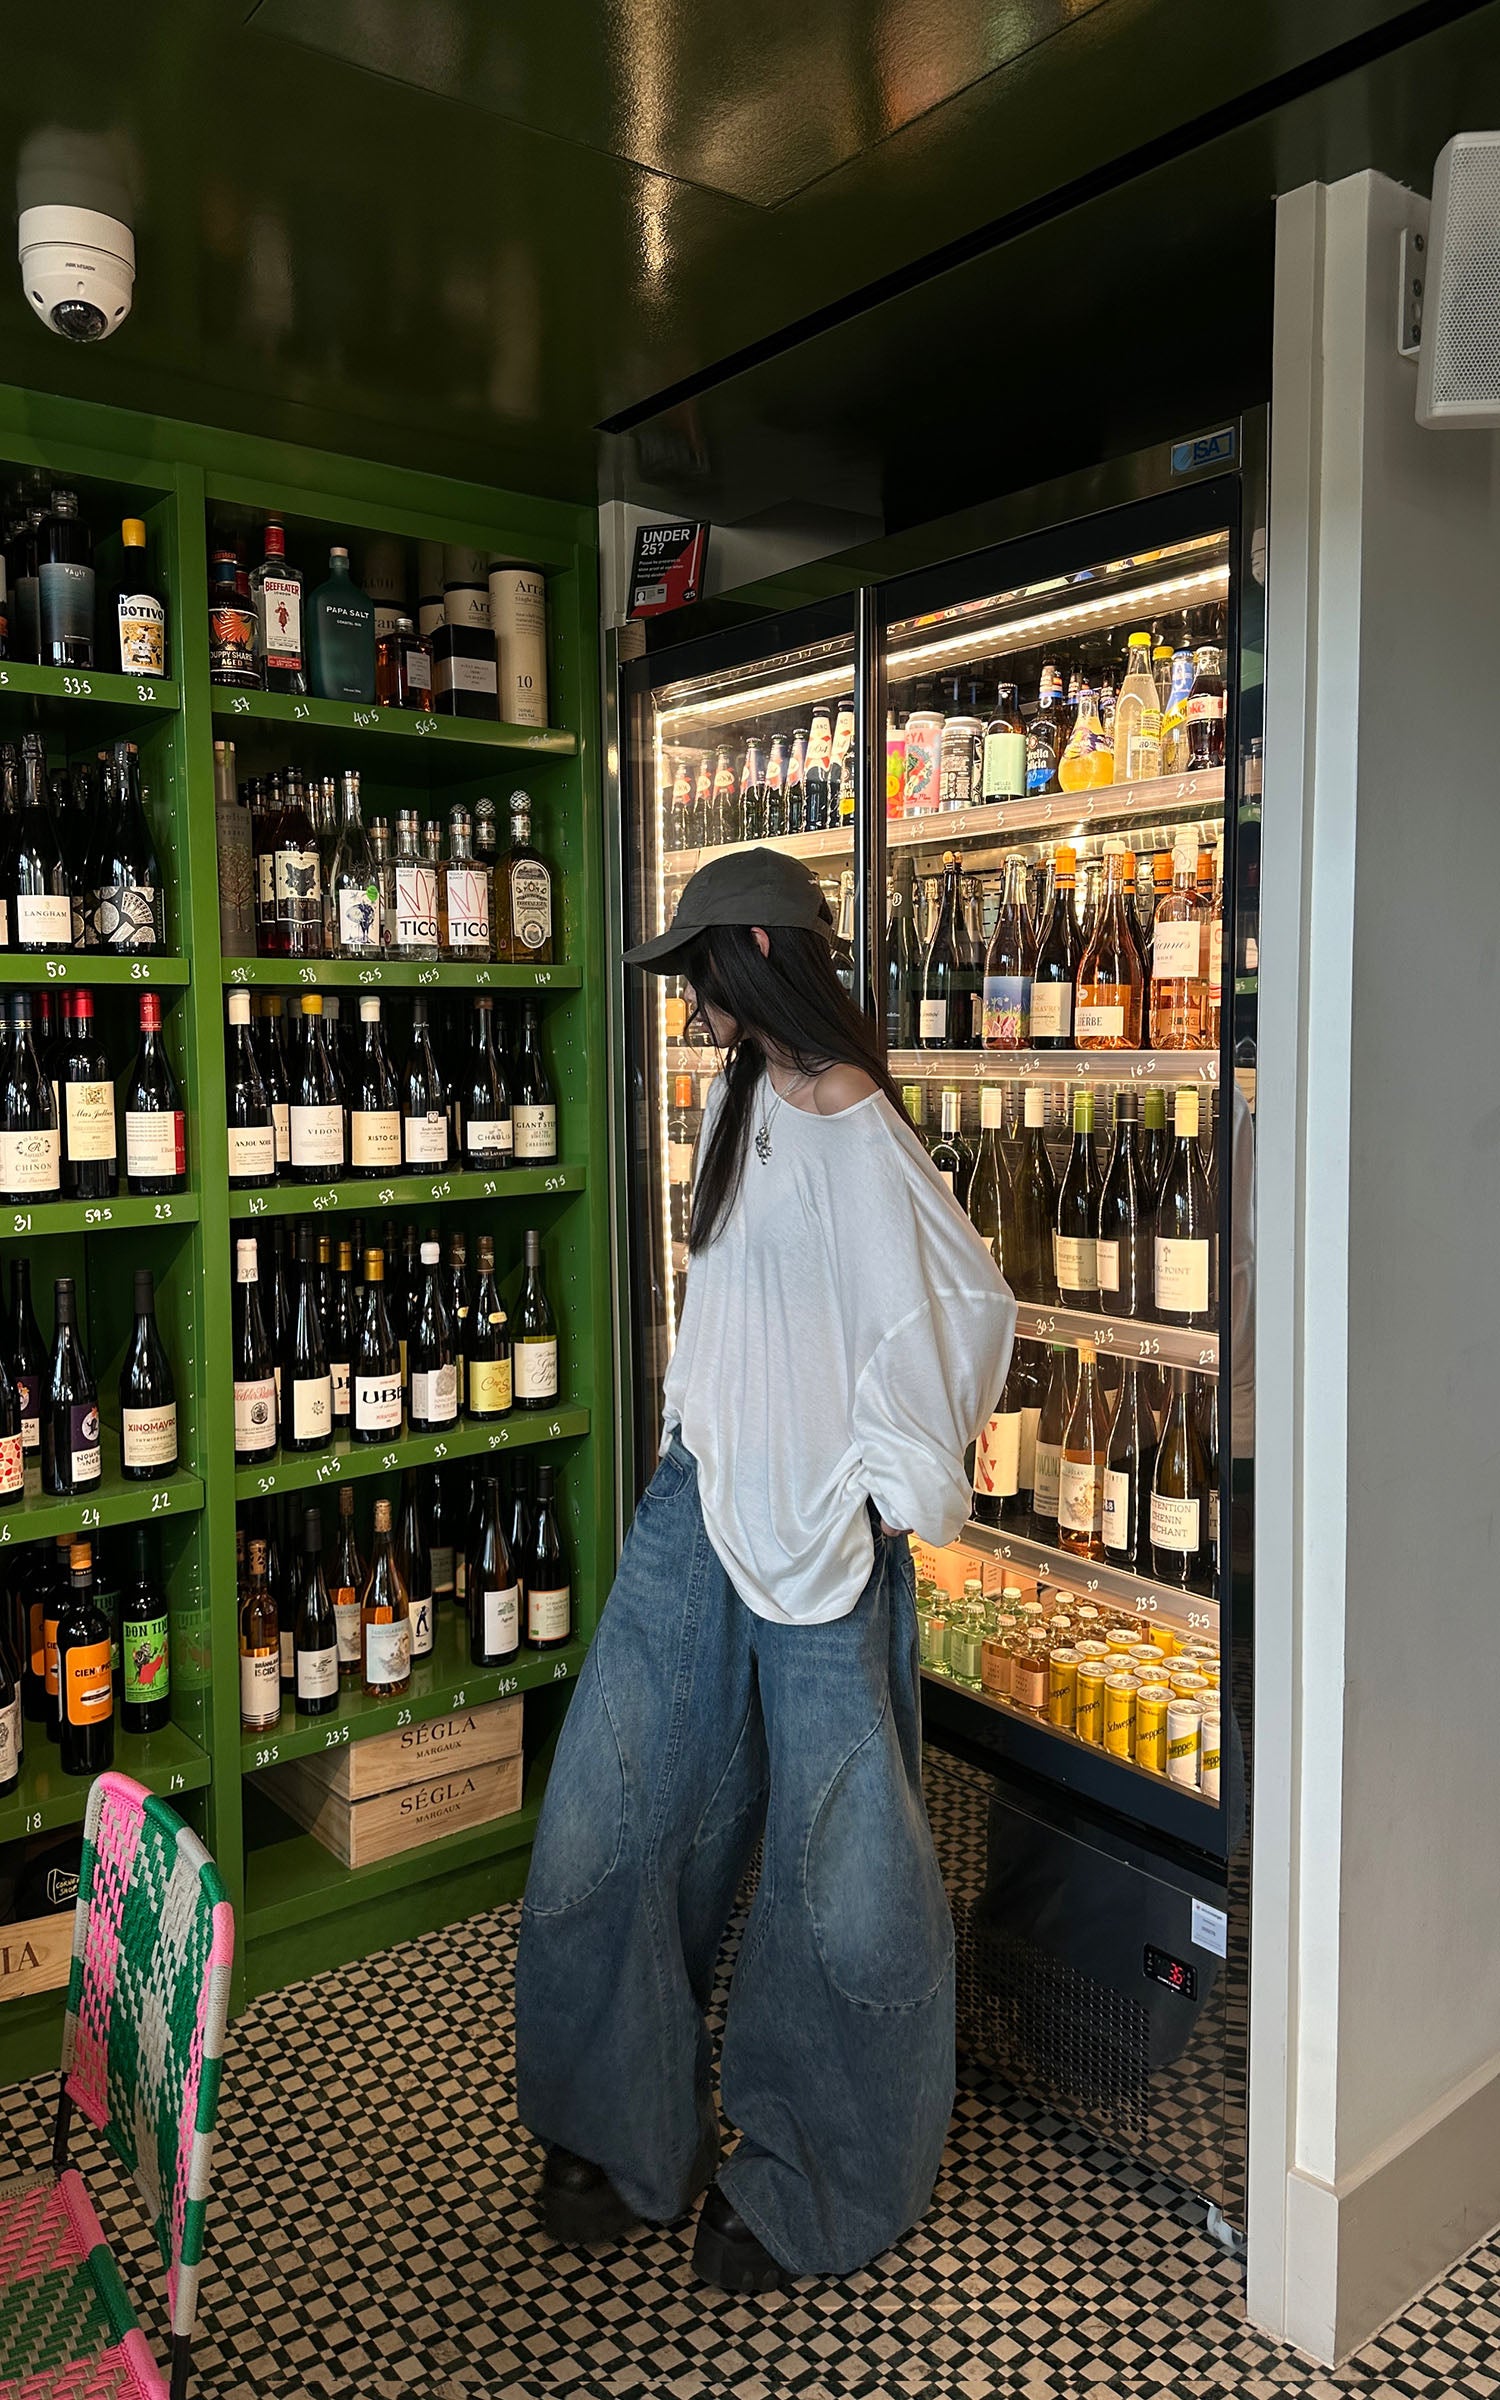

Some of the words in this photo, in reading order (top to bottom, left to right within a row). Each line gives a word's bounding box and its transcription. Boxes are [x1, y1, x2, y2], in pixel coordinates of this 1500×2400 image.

[1194, 438, 1220, 460] ISA
[643, 528, 690, 544] UNDER
[640, 542, 664, 556] 25?
[64, 567, 86, 577] VAULT
[266, 581, 299, 594] BEEFEATER
[120, 605, 164, 620] BOTIVO
[326, 606, 348, 615] PAPA
[350, 610, 369, 619] SALT
[221, 658, 242, 666] AGED
[232, 651, 252, 662] SHARE
[64, 677, 92, 694] 33.5
[517, 675, 532, 689] 10
[137, 685, 156, 701] 32
[231, 696, 250, 712] 37
[294, 704, 310, 718] 21
[353, 709, 379, 727] 40.5
[415, 718, 438, 735] 56.5
[1177, 780, 1197, 798] 2.5
[1086, 798, 1094, 814] 3
[1126, 791, 1134, 805] 2
[997, 812, 1004, 827] 3
[1045, 804, 1052, 819] 3
[950, 816, 966, 834] 3.5
[24, 910, 67, 918] LANGHAM
[400, 921, 436, 936] TICO
[451, 922, 488, 937] TICO
[46, 962, 66, 978] 50
[130, 964, 150, 978] 36
[300, 967, 317, 983] 38
[359, 967, 382, 984] 52.5
[418, 968, 440, 985] 45.5
[476, 972, 491, 984] 49
[535, 972, 551, 985] 140
[1018, 1058, 1040, 1076] 22.5
[1075, 1062, 1090, 1077] 30
[1131, 1058, 1156, 1078] 16.5
[1199, 1061, 1217, 1081] 18
[15, 1163, 52, 1171] CHINON
[431, 1181, 451, 1199] 51.5
[484, 1181, 497, 1195] 39
[545, 1174, 566, 1191] 59.5
[313, 1189, 338, 1210] 54.5
[378, 1189, 394, 1205] 57
[154, 1204, 172, 1219] 23
[249, 1198, 268, 1214] 42
[14, 1214, 31, 1232] 31
[85, 1208, 112, 1223] 59.5
[1164, 1266, 1190, 1275] POINT
[1036, 1313, 1056, 1335] 30.5
[1094, 1328, 1114, 1345] 32.5
[1139, 1338, 1159, 1355] 28.5
[1200, 1350, 1216, 1365] 27
[127, 1417, 176, 1432] XINOMAVRO
[549, 1422, 561, 1436] 15
[488, 1429, 509, 1448] 30.5
[434, 1442, 447, 1458] 33
[316, 1457, 341, 1481] 19.5
[382, 1453, 398, 1469] 32
[258, 1476, 275, 1492] 30
[151, 1492, 171, 1512] 22
[81, 1508, 100, 1526] 24
[993, 1545, 1011, 1560] 31.5
[1039, 1563, 1050, 1577] 23
[1087, 1580, 1099, 1592] 30
[1187, 1613, 1210, 1629] 32.5
[125, 1624, 148, 1638] DON
[75, 1668, 95, 1678] CIEN
[553, 1663, 567, 1679] 43
[498, 1677, 518, 1696] 48.5
[453, 1691, 466, 1708] 28
[397, 1709, 411, 1725] 23
[326, 1726, 349, 1747] 23.5
[400, 1716, 477, 1750] SÉGLA
[256, 1746, 279, 1767] 38.5
[416, 1740, 462, 1759] MARGAUX
[170, 1774, 184, 1789] 14
[399, 1777, 476, 1816] SÉGLA
[415, 1802, 461, 1825] MARGAUX
[26, 1813, 42, 1831] 18
